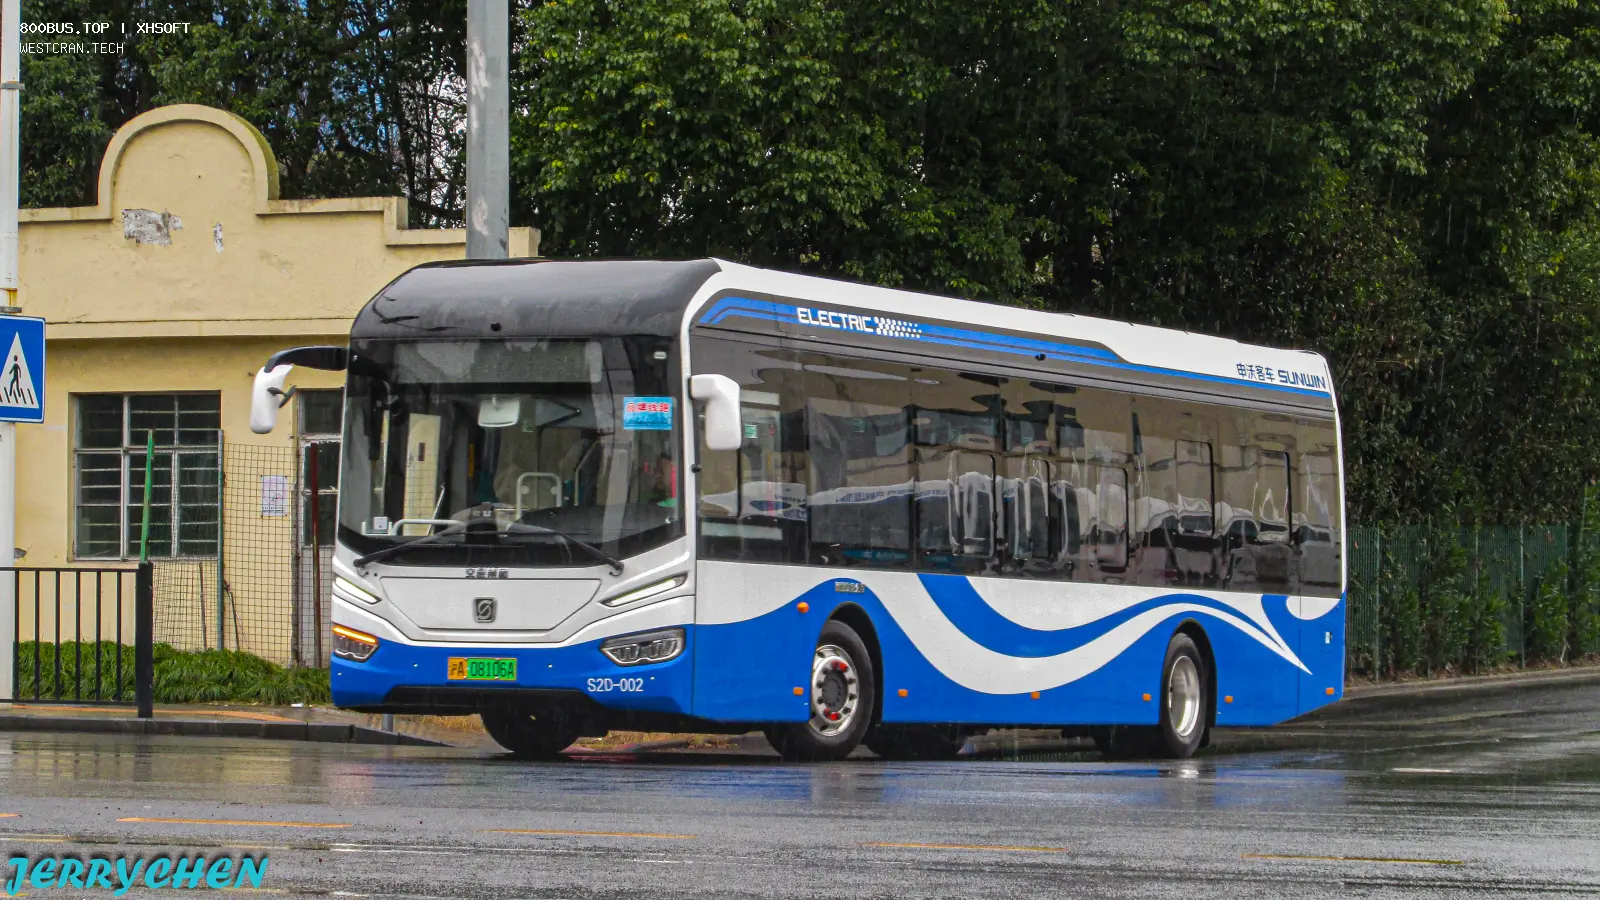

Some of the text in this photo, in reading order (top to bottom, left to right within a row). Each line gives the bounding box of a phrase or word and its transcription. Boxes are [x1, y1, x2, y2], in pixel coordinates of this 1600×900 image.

[797, 307, 874, 332] ELECTRIC
[1236, 363, 1327, 389] 申沃客车 SUNWIN
[587, 678, 644, 692] S2D-002
